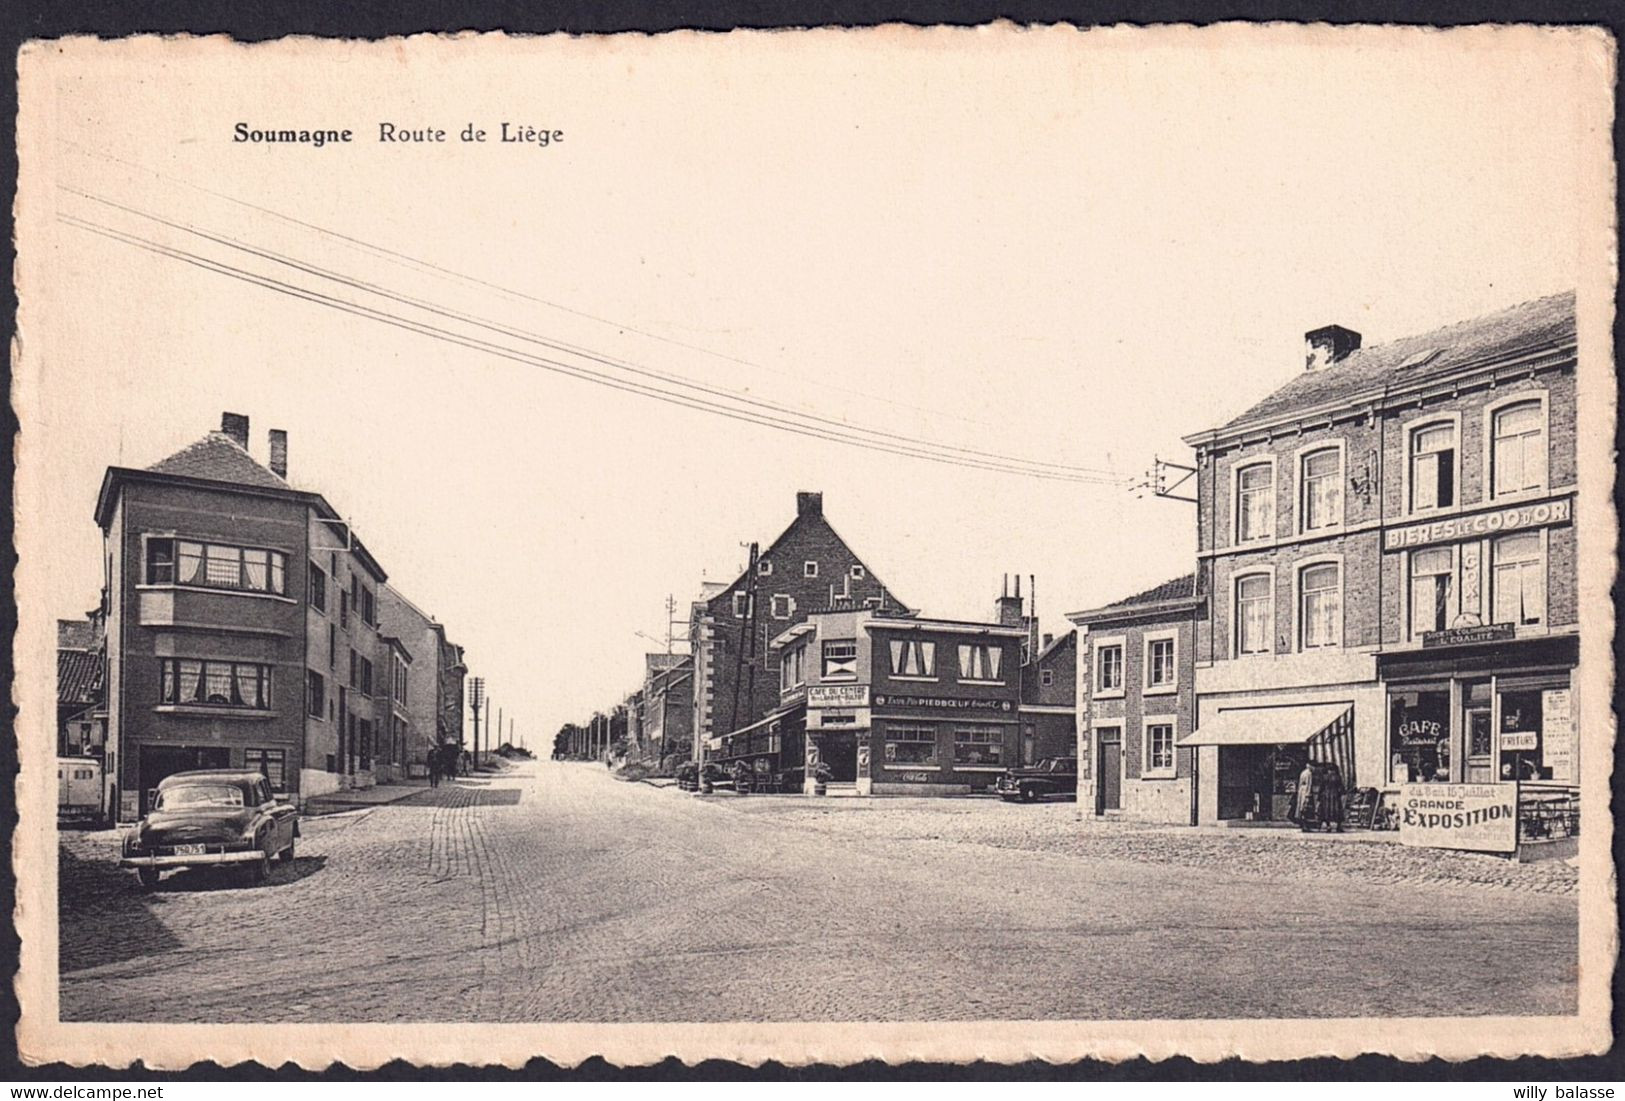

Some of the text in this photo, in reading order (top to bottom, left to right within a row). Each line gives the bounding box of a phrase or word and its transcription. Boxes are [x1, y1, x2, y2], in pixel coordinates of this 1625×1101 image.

[1457, 523, 1471, 536] LE
[1473, 508, 1521, 533] COQ
[1399, 720, 1441, 737] CAFE
[1408, 799, 1465, 810] GRANDE
[1403, 804, 1513, 829] EXPOSITION
